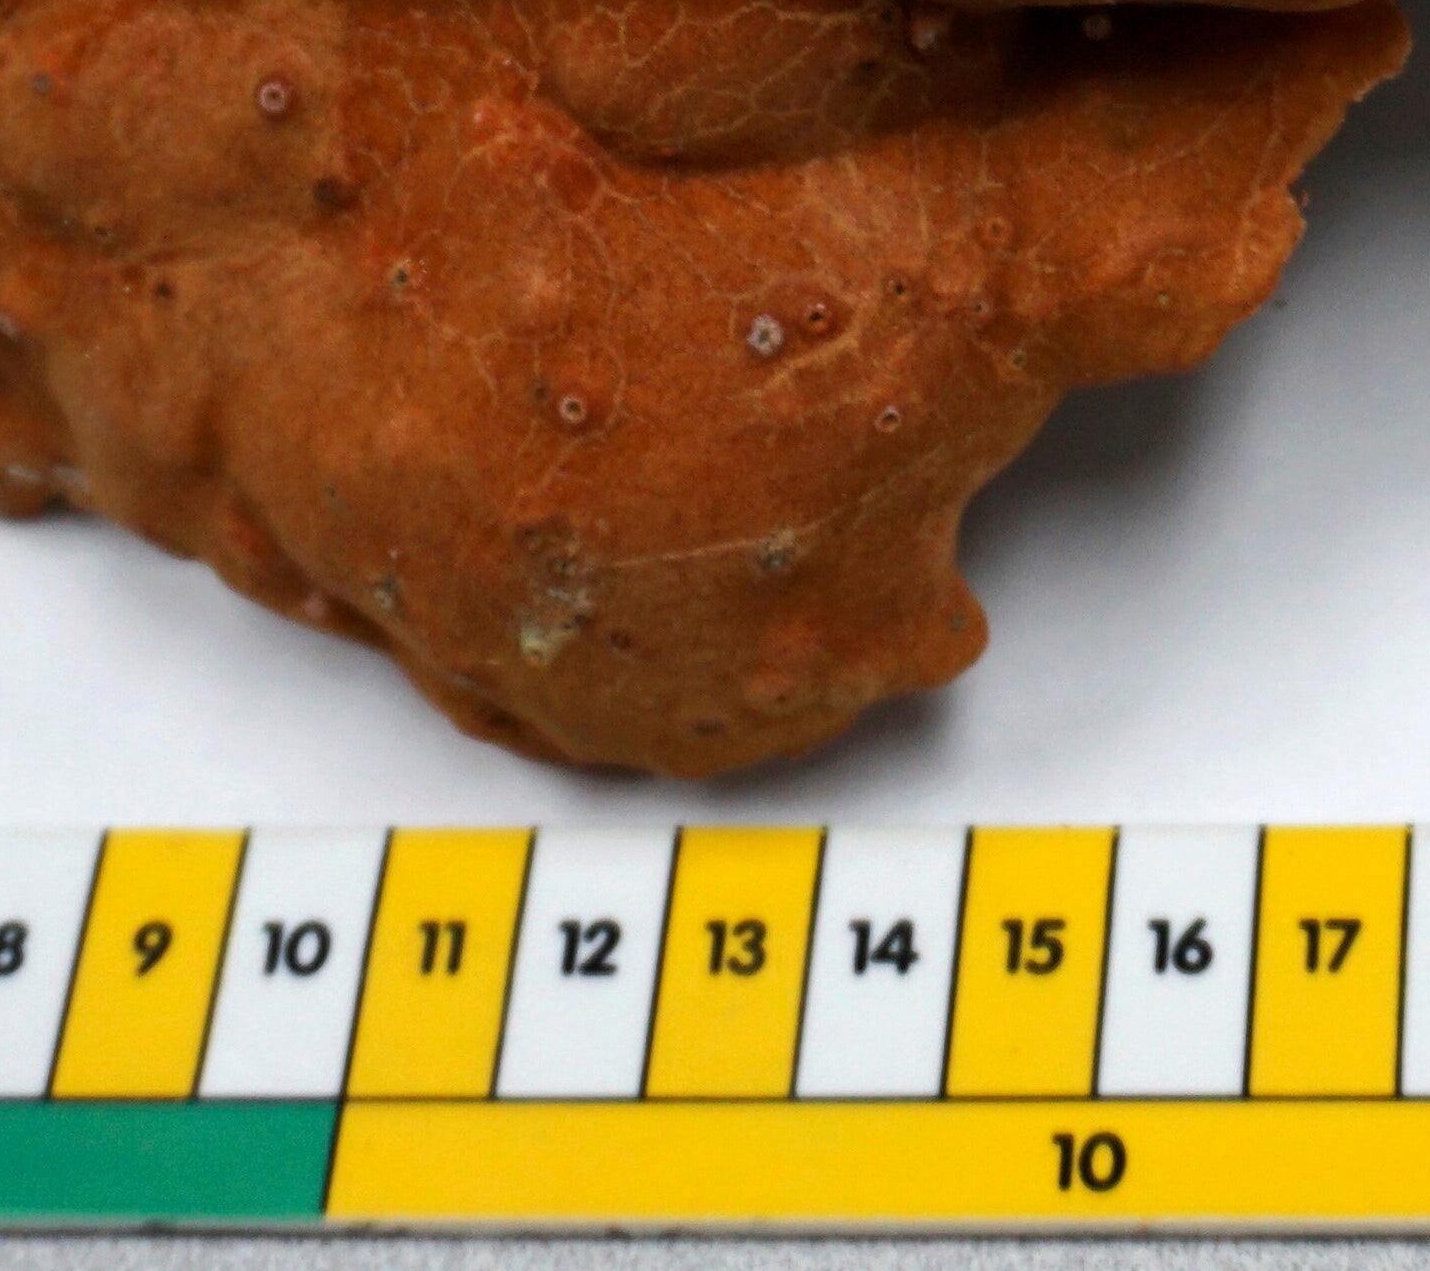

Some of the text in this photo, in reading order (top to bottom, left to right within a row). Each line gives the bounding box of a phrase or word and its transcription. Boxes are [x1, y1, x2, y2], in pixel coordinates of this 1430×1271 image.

[133, 922, 173, 976] 9
[264, 920, 332, 977] 10
[421, 921, 466, 975] 11
[559, 919, 622, 977] 12
[707, 920, 767, 977] 13
[849, 919, 919, 975] 14
[1003, 919, 1065, 976] 15
[1148, 918, 1214, 976] 16
[1299, 919, 1362, 973] 17
[1051, 1129, 1127, 1196] 10
